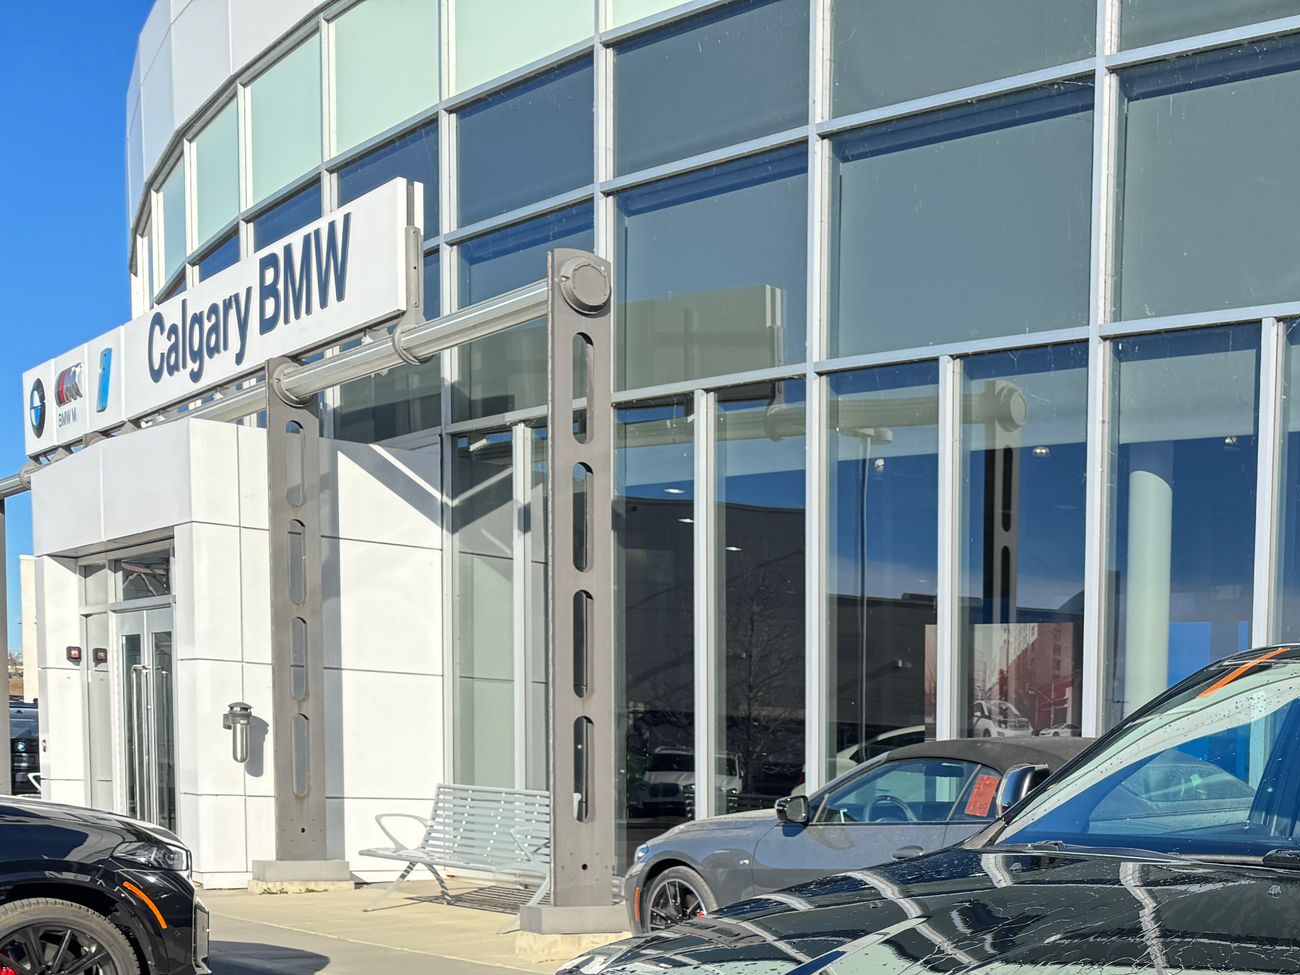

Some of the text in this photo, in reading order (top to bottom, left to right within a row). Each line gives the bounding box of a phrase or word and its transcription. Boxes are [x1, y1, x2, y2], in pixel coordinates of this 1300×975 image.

[148, 212, 352, 384] Calgary BMW
[58, 406, 77, 428] BMW M
